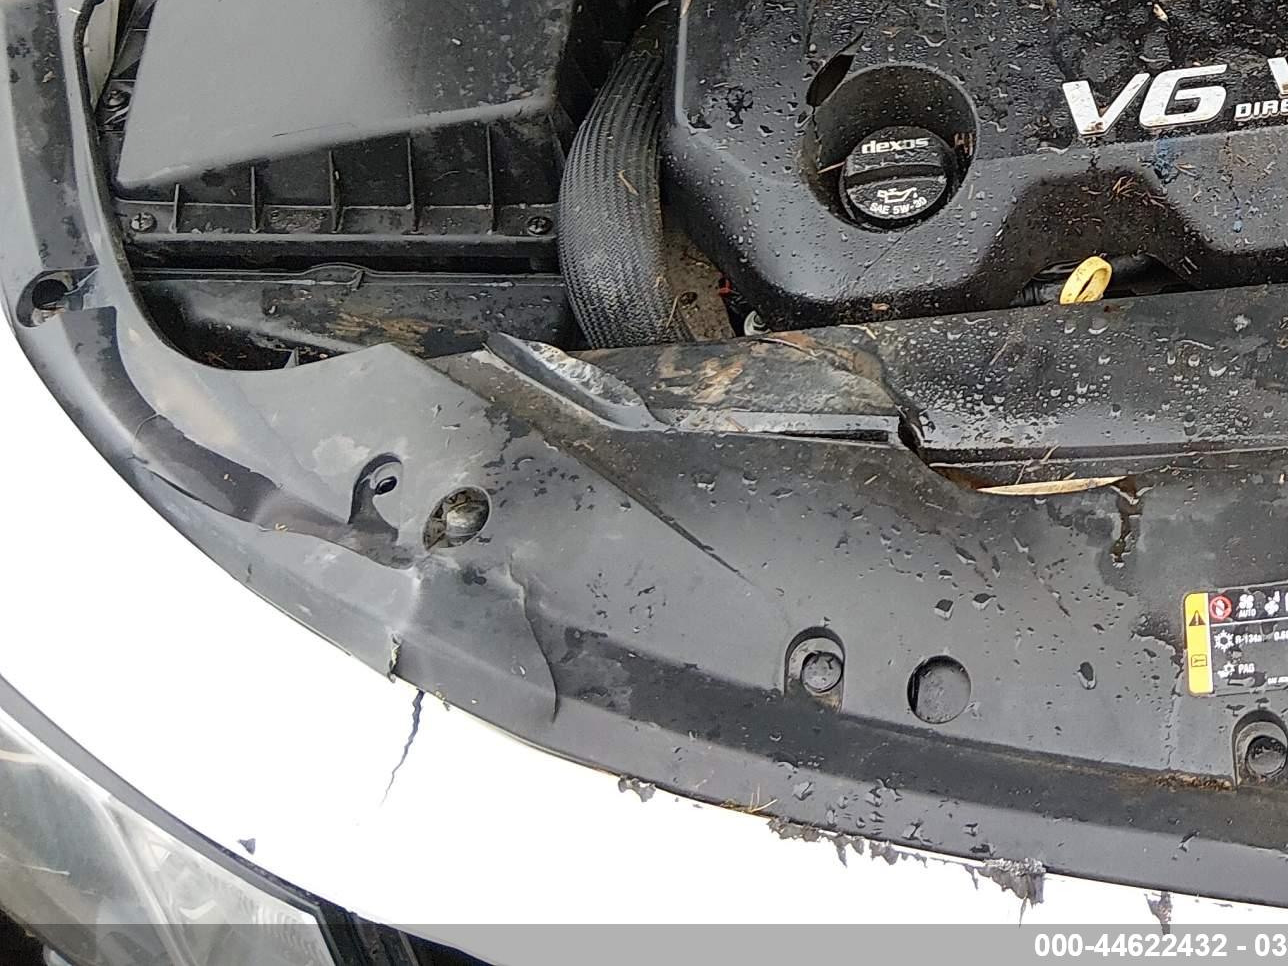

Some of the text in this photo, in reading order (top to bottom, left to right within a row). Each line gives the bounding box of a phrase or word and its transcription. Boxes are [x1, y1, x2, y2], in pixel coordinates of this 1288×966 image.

[1062, 64, 1228, 136] V6
[861, 137, 930, 154] dexos
[870, 196, 928, 214] SAE 5W-30
[1239, 609, 1256, 618] AUTO
[1235, 633, 1262, 644] R-134a
[1238, 663, 1255, 675] PAG
